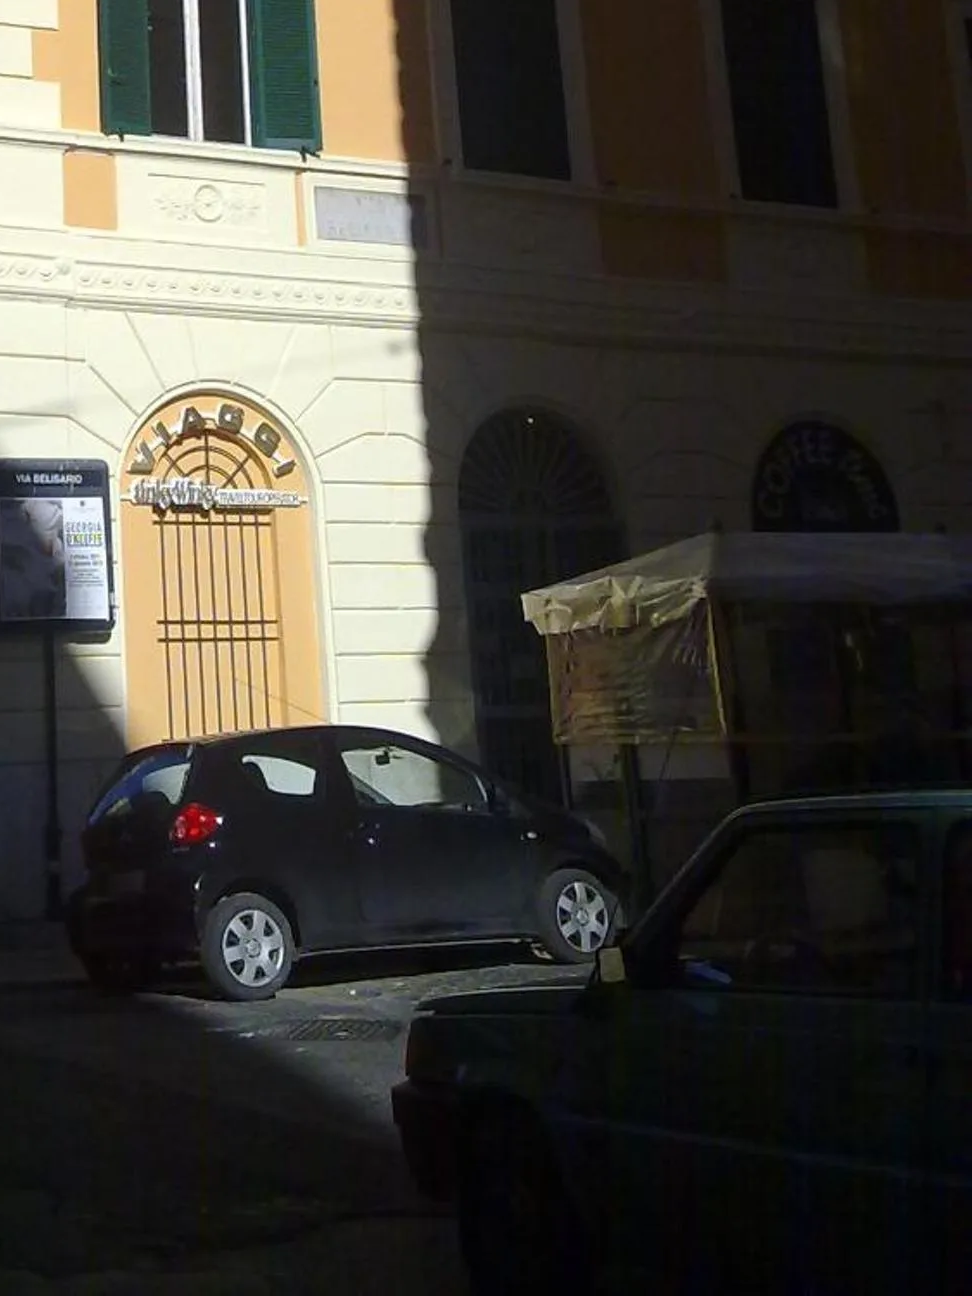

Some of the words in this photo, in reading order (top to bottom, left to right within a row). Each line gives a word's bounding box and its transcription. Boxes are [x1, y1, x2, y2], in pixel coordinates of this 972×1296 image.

[126, 404, 297, 479] VIAGGI
[15, 473, 31, 484] VIA
[33, 473, 83, 484] BELISARIO
